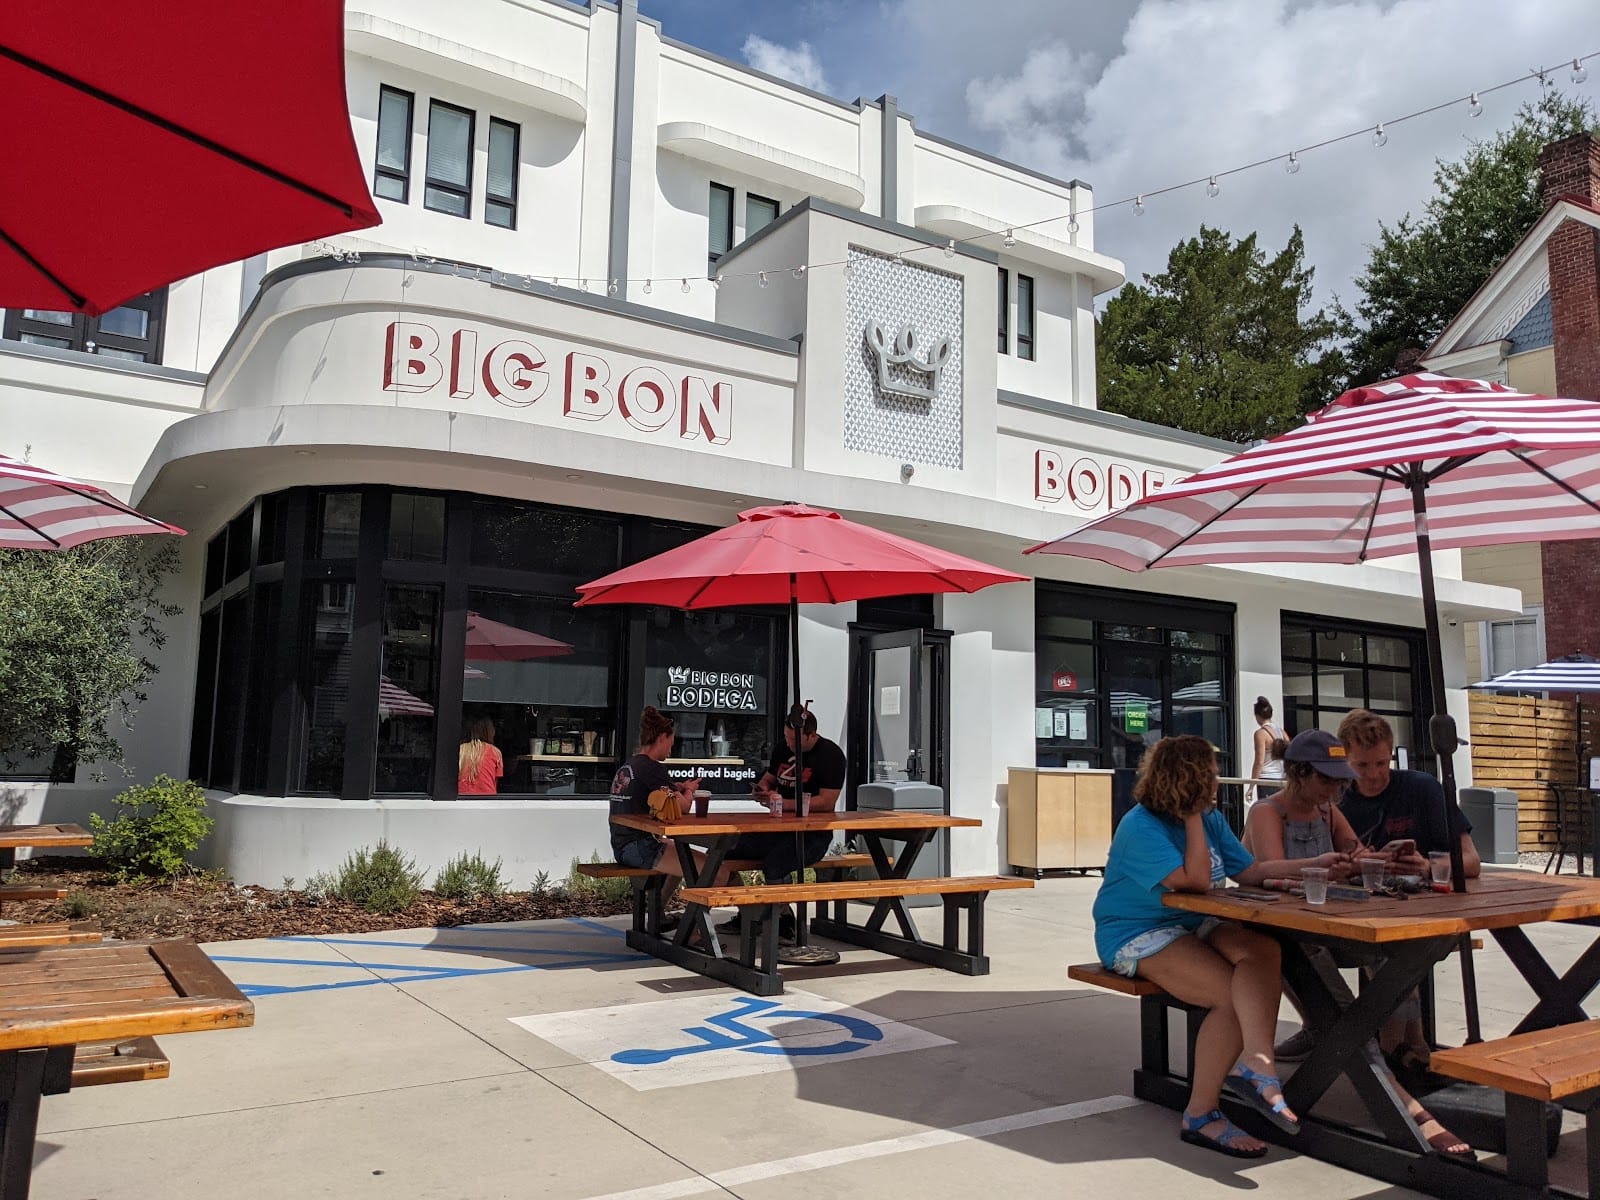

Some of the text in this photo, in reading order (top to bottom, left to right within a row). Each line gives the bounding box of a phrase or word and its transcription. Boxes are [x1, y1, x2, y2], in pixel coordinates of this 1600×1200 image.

[383, 321, 733, 445] BIG BON
[1034, 449, 1187, 512] BODE
[691, 670, 754, 688] BIG BON
[666, 685, 758, 710] BODEGA
[1130, 719, 1144, 727] HERE
[697, 767, 721, 778] fired
[723, 767, 756, 781] bagels
